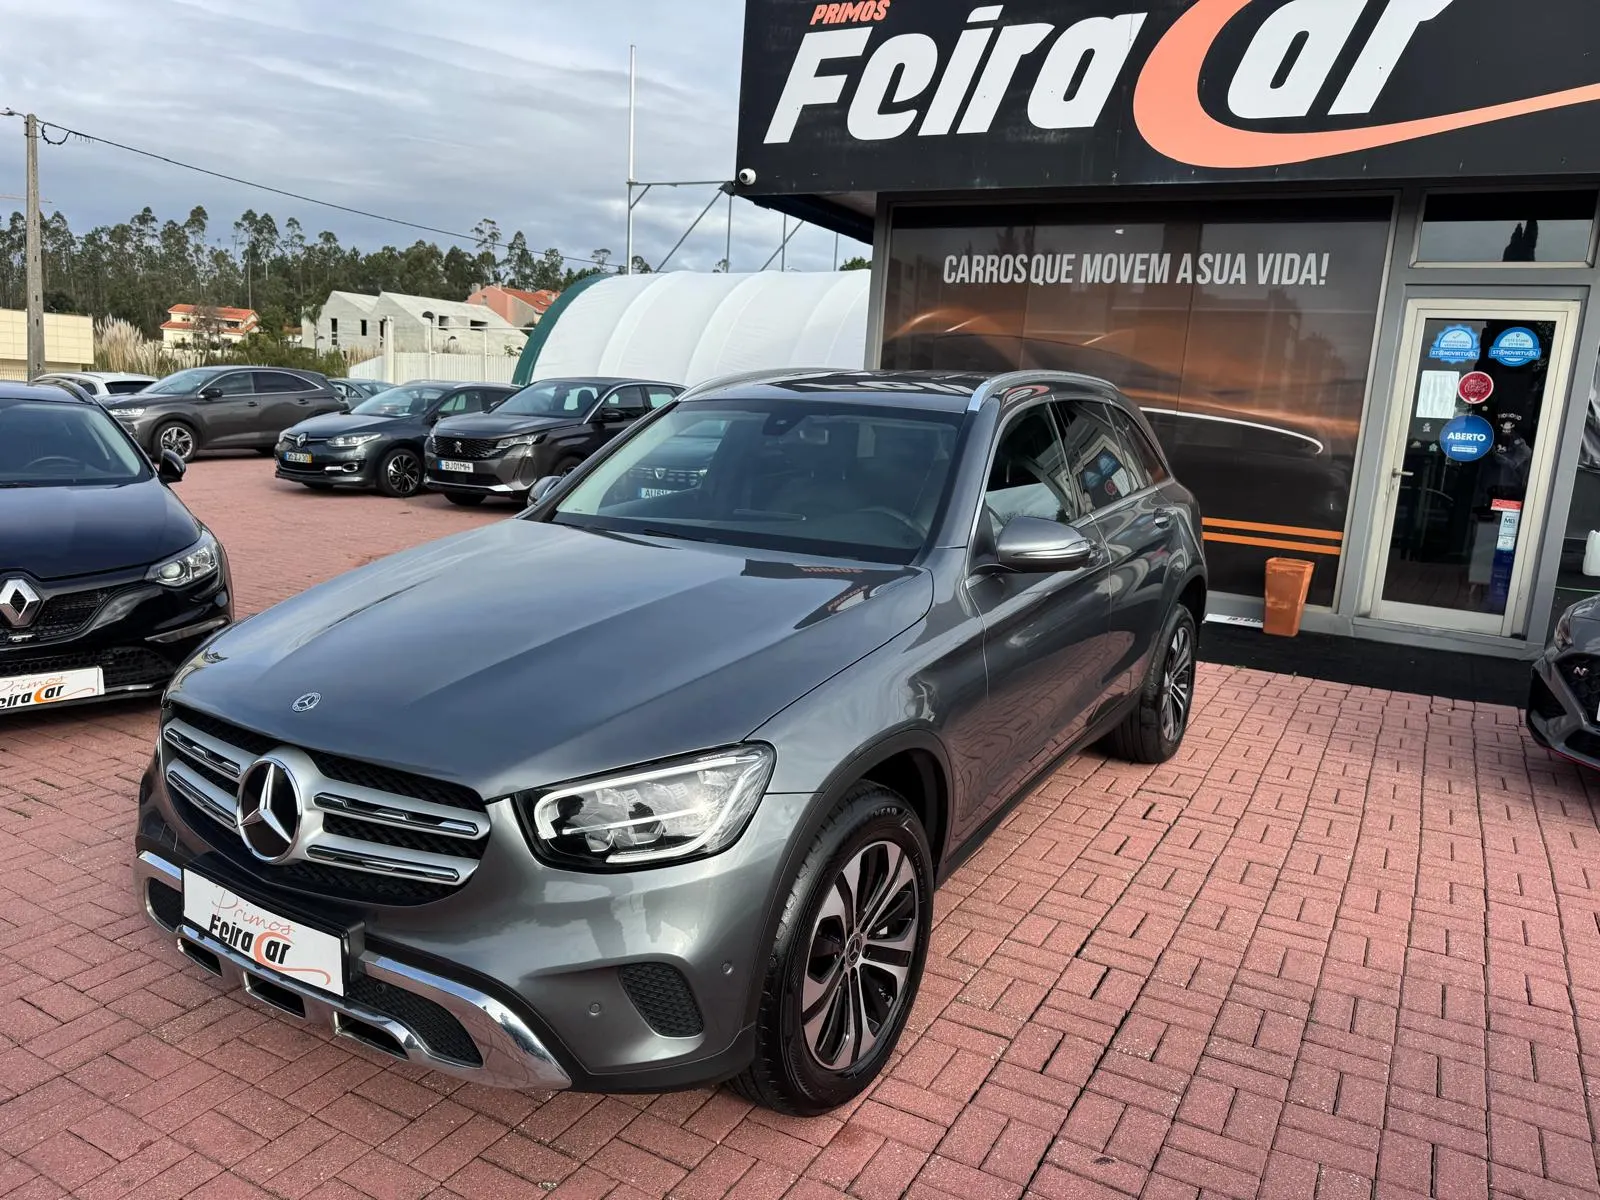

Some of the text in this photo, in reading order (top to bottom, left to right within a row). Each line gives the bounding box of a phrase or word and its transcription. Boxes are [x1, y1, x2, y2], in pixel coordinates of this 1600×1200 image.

[809, 0, 891, 25] PRIMOS
[943, 253, 1330, 286] CARROS QUE MOVEM A SUA VIDA!
[1447, 432, 1486, 442] ABERTO
[211, 889, 296, 935] Primos
